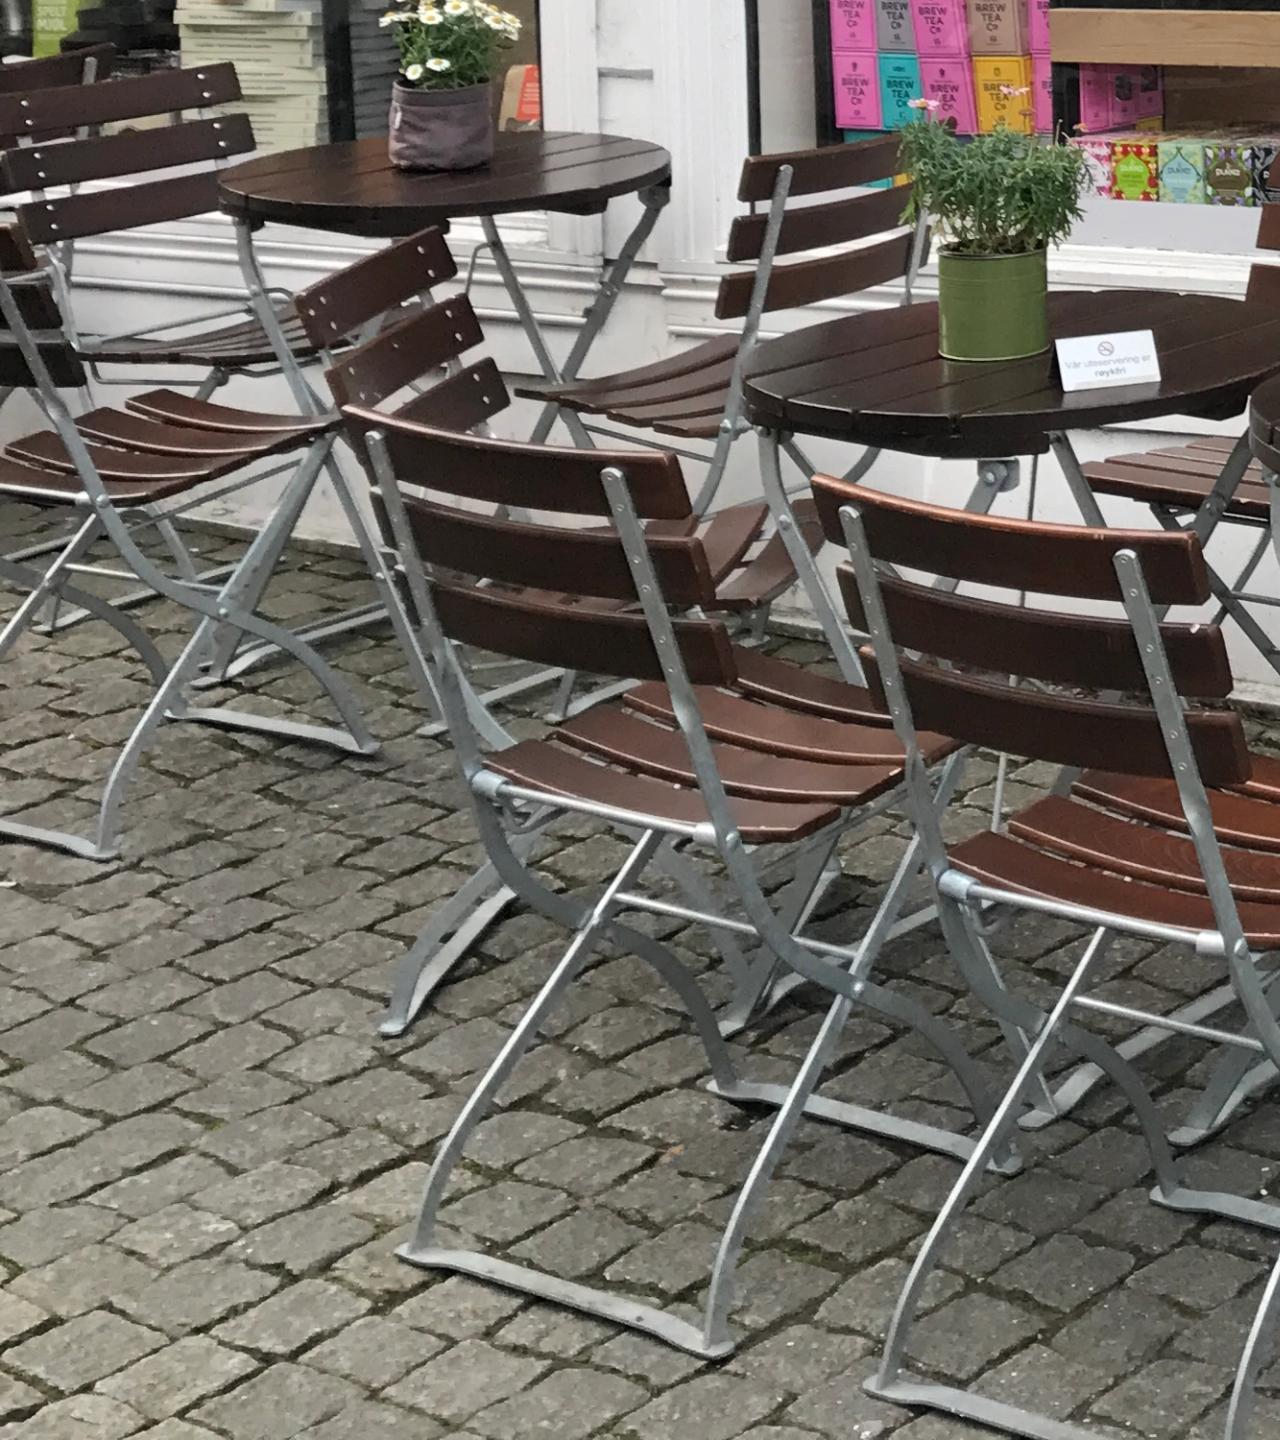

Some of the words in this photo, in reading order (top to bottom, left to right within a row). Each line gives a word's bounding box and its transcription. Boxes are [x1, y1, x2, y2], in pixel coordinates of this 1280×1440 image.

[837, 0, 864, 9] BREW
[881, 1, 908, 10] BREW
[975, 3, 1006, 13] BREW
[843, 10, 860, 19] TEA
[886, 11, 904, 20] TEA
[918, 7, 946, 16] BREW
[925, 16, 944, 25] TEA
[981, 13, 1002, 22] TEA
[841, 78, 869, 86] BREW
[886, 80, 914, 89] BREW
[847, 87, 865, 96] TEA
[930, 84, 959, 93] BREW
[891, 90, 910, 99] TEA
